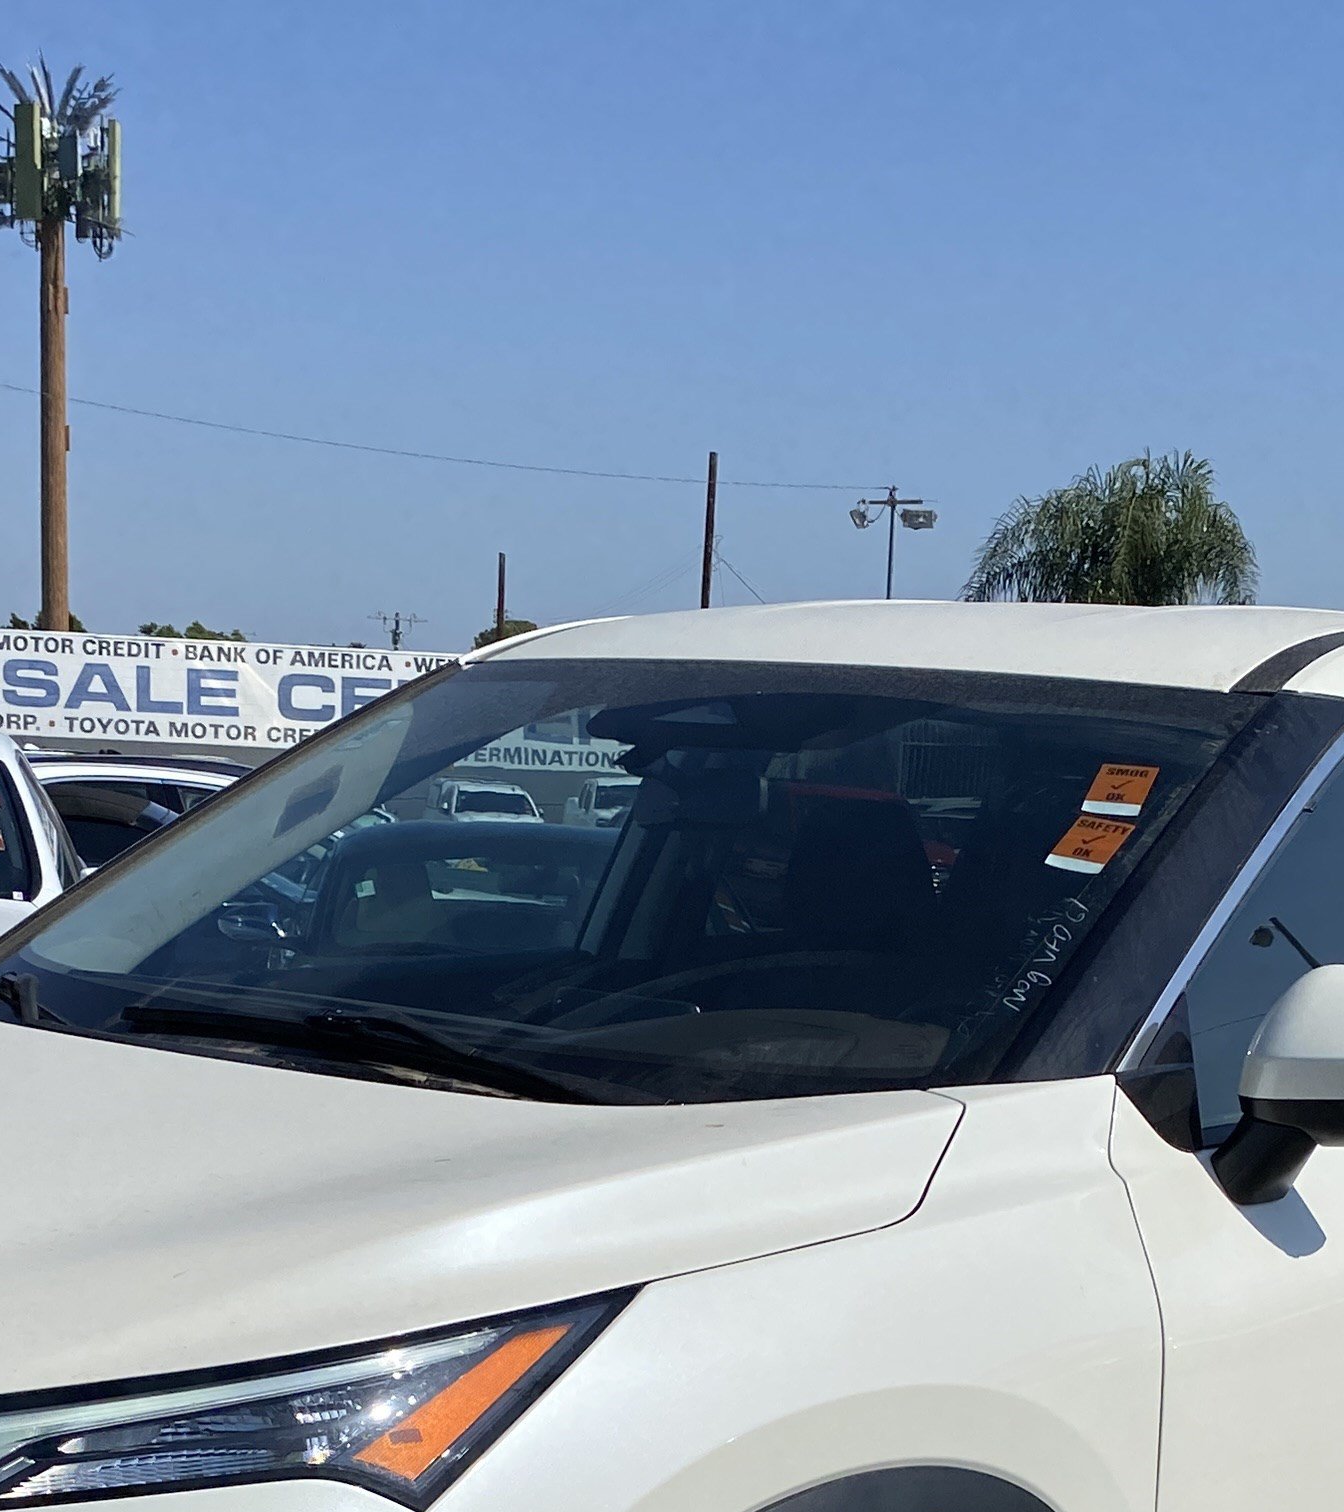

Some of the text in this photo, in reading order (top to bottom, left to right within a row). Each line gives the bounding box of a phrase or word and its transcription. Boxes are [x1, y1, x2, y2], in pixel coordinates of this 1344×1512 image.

[82, 638, 165, 659] CREDIT
[184, 645, 246, 664] BANK
[256, 648, 283, 666] OF
[289, 651, 393, 672] AMERICA
[278, 673, 410, 722] CE
[64, 716, 160, 737] TOYOTA
[168, 721, 257, 742] MOTOR
[267, 726, 321, 744] CRE
[1105, 767, 1150, 779] SMOG
[1105, 792, 1126, 802] OK
[1077, 819, 1131, 836] SAFETY
[1071, 846, 1094, 859] OK
